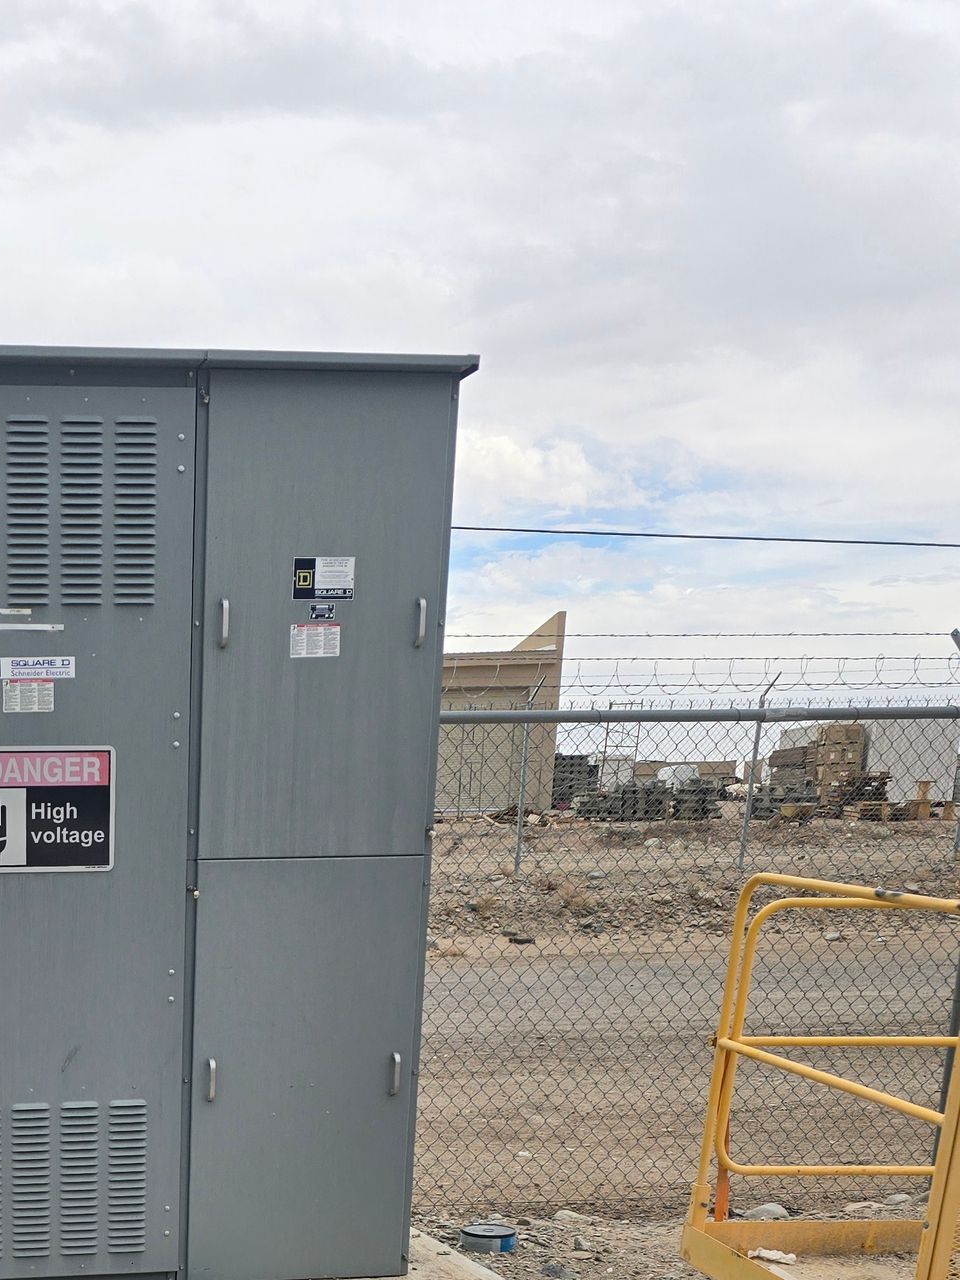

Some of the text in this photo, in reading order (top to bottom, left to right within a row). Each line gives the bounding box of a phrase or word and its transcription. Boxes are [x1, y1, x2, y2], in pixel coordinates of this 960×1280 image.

[10, 659, 57, 667] SQUARE
[10, 669, 71, 677] Schneider Electric
[31, 802, 78, 824] High
[31, 827, 105, 847] voltage
